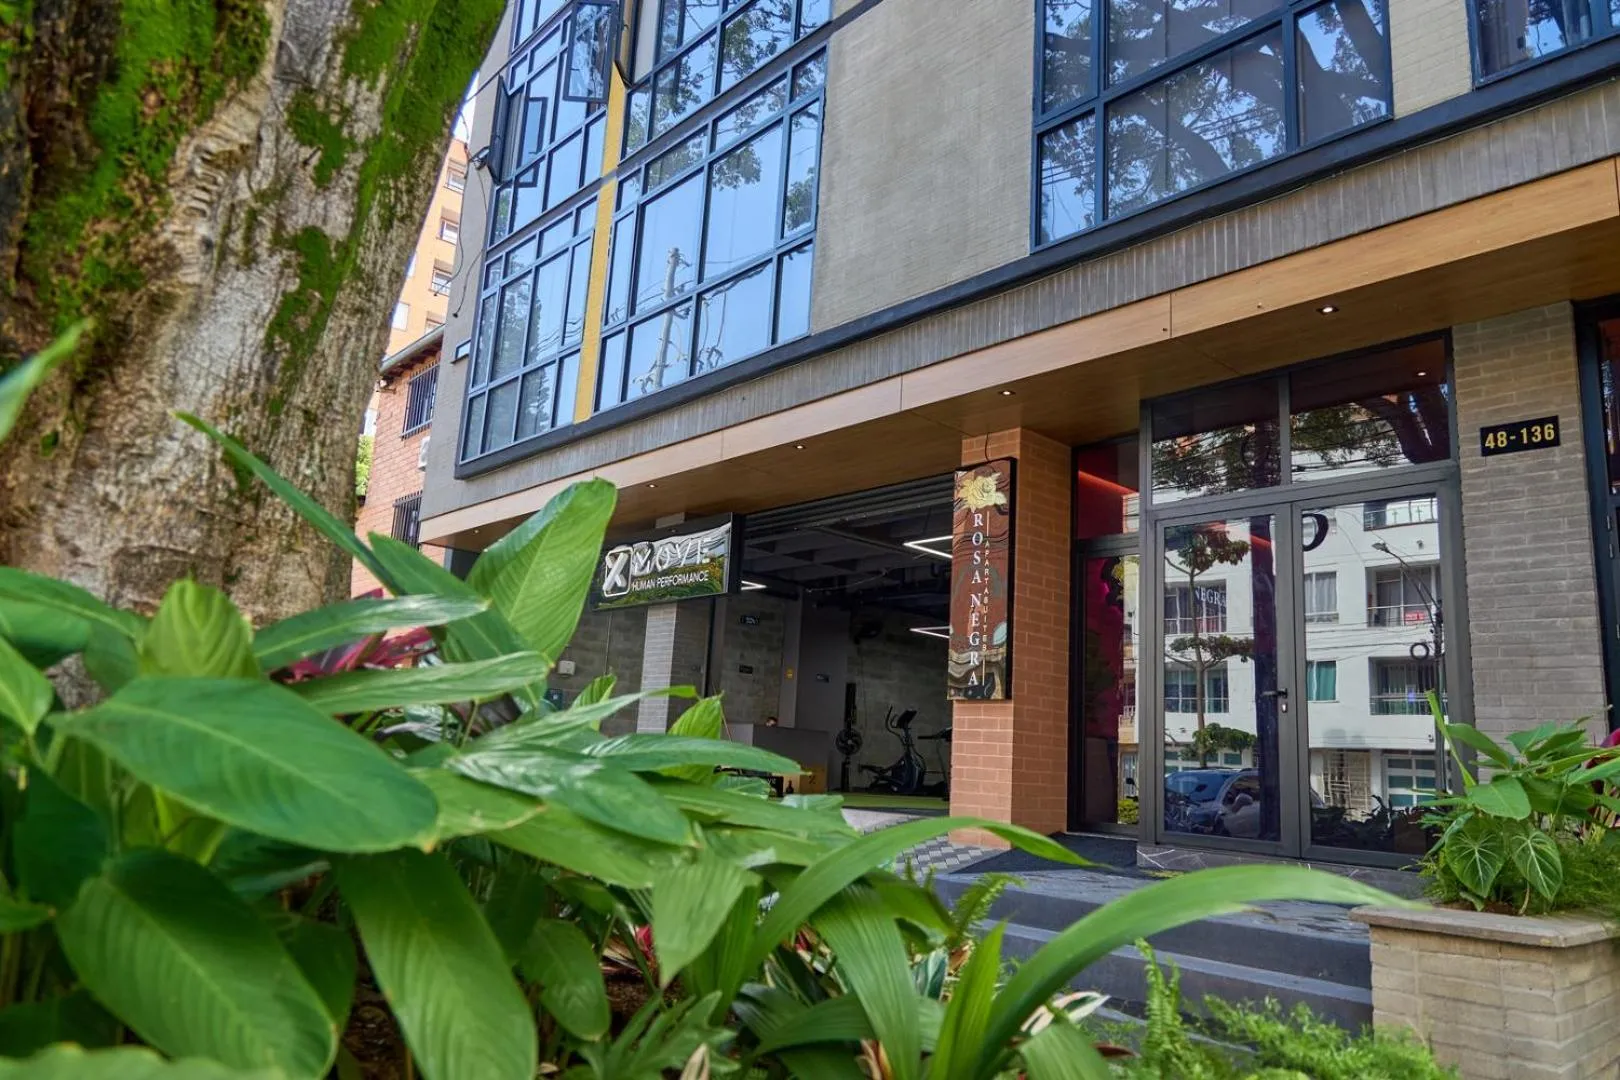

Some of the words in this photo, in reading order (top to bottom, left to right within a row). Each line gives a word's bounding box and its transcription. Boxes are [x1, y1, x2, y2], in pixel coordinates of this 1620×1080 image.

[1484, 423, 1555, 449] 48-136
[971, 513, 984, 584] ROSA
[631, 578, 656, 592] HUMAN
[656, 570, 709, 589] PERFORMANCE
[968, 593, 982, 687] NEGRA
